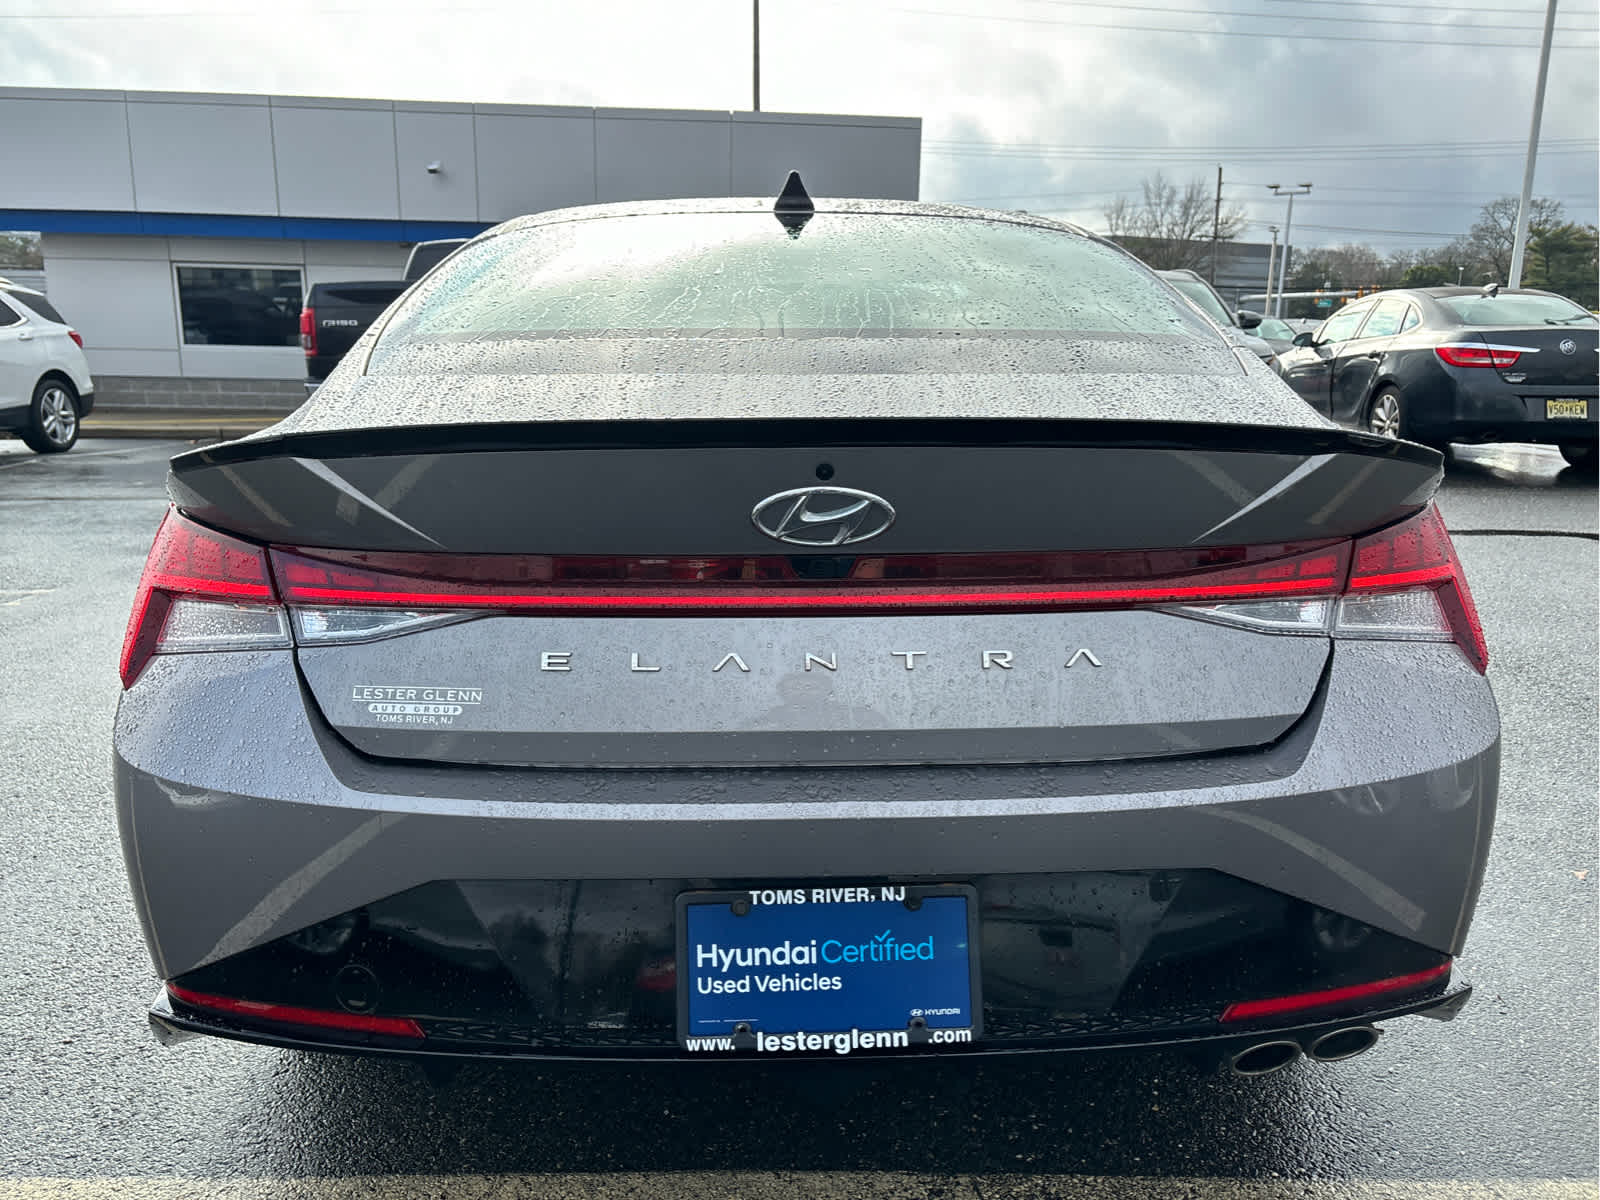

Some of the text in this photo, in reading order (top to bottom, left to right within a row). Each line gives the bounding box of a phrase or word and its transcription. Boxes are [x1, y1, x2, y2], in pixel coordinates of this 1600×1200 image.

[540, 648, 1103, 672] ELANTRA
[352, 687, 483, 701] LESTER GLENN
[371, 704, 460, 714] AUTO GROUP
[375, 714, 454, 725] TOMS RIVER, NJ
[749, 886, 906, 906] TOMS RIVER, NJ
[696, 930, 935, 972] Hyundai Certified
[696, 973, 842, 995] Used Vehicles
[924, 1007, 961, 1016] HYUNDAI
[685, 1029, 972, 1054] www. lesterglenn .com
